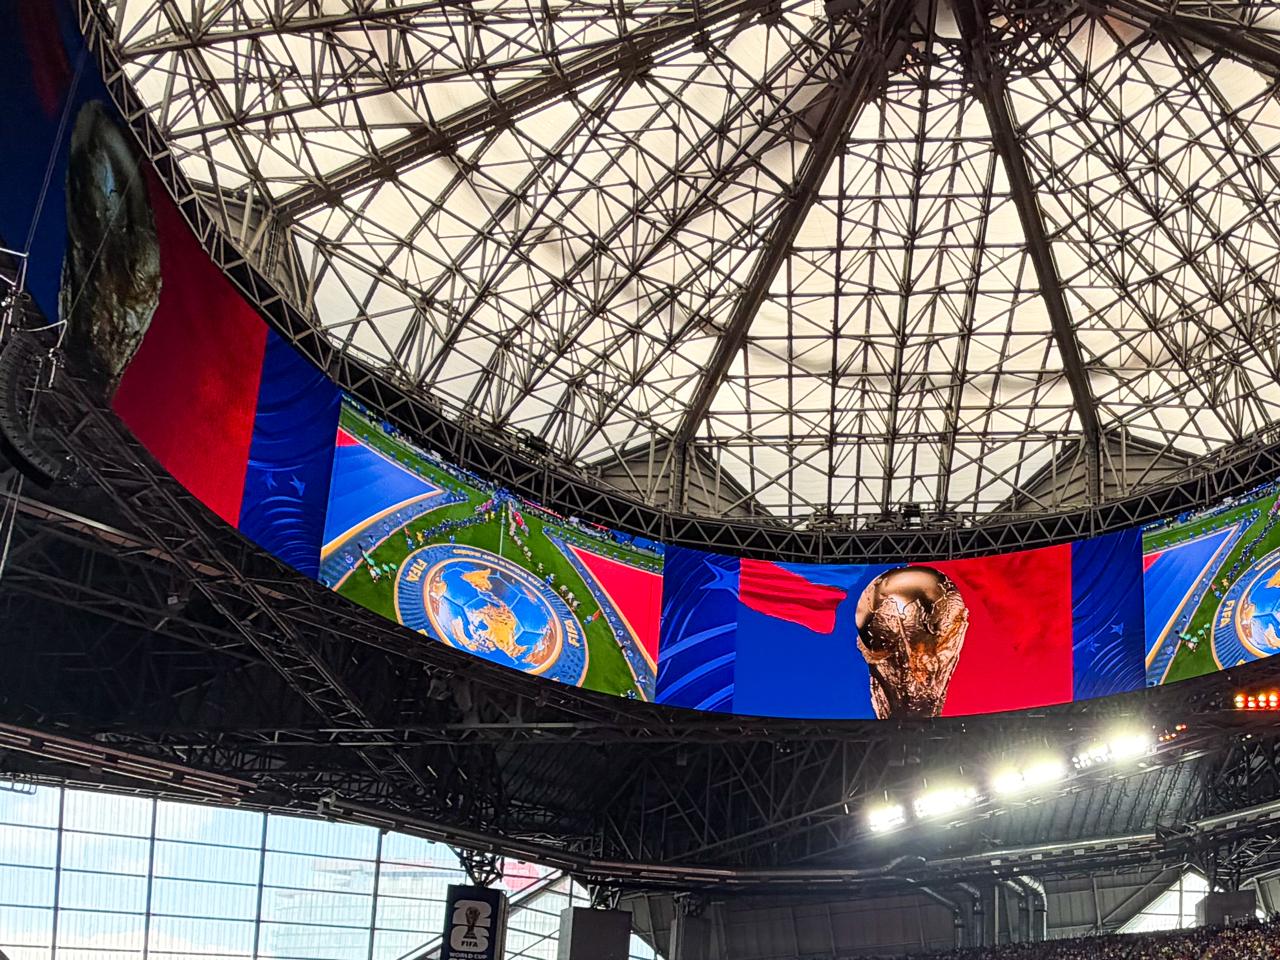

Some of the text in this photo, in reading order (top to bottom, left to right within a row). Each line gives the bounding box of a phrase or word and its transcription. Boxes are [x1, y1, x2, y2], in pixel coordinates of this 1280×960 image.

[405, 558, 427, 582] FIFA
[1218, 600, 1235, 628] FIFA
[563, 619, 581, 648] FIFA
